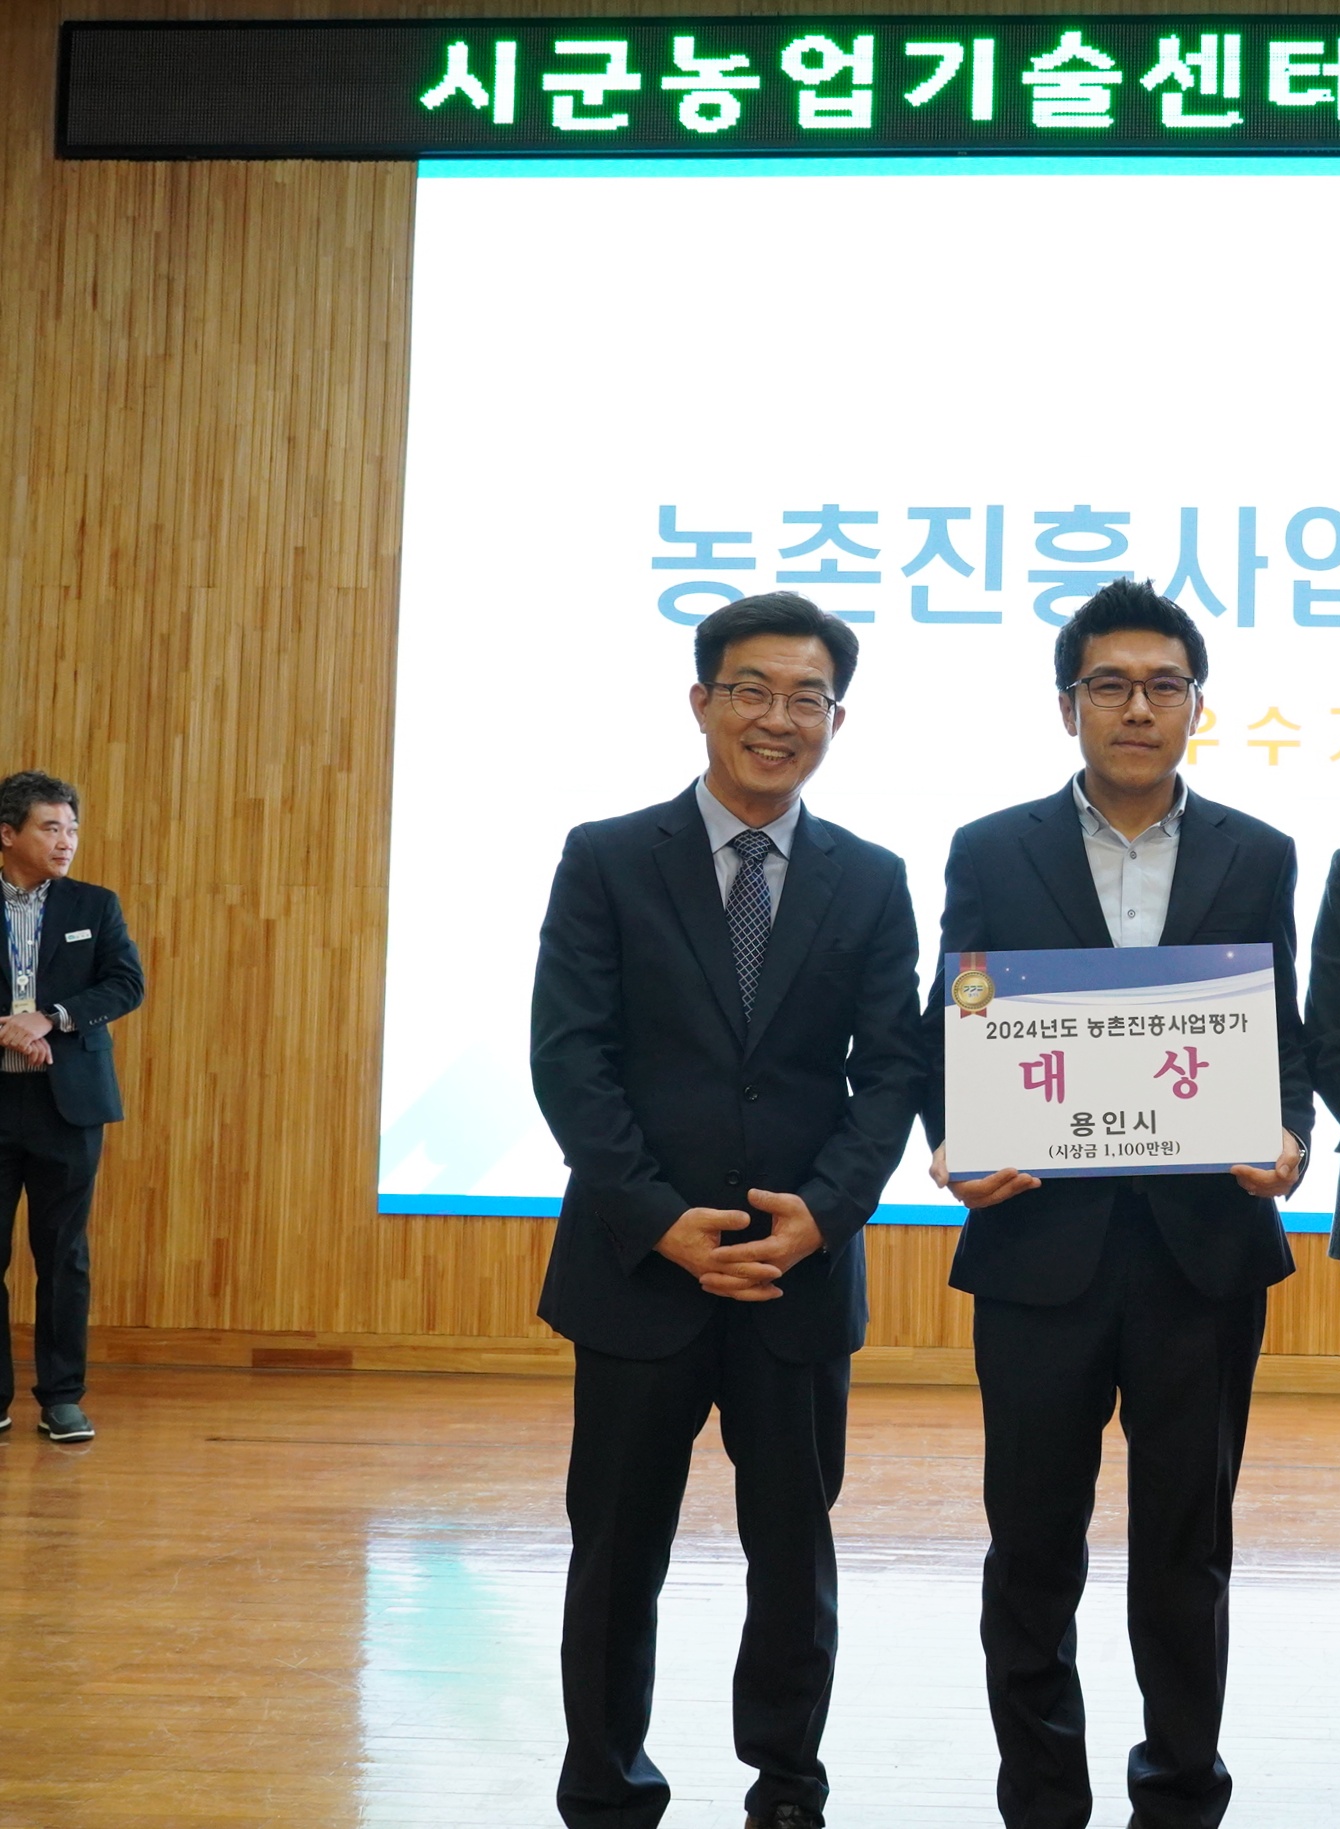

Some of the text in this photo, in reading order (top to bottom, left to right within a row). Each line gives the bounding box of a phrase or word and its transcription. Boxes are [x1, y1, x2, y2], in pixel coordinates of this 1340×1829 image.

[986, 1013, 1249, 1039] 2024년도 농촌진흥사업평가
[1070, 1110, 1158, 1137] 용인시
[1048, 1140, 1181, 1160] (시상금 1,100만원)
